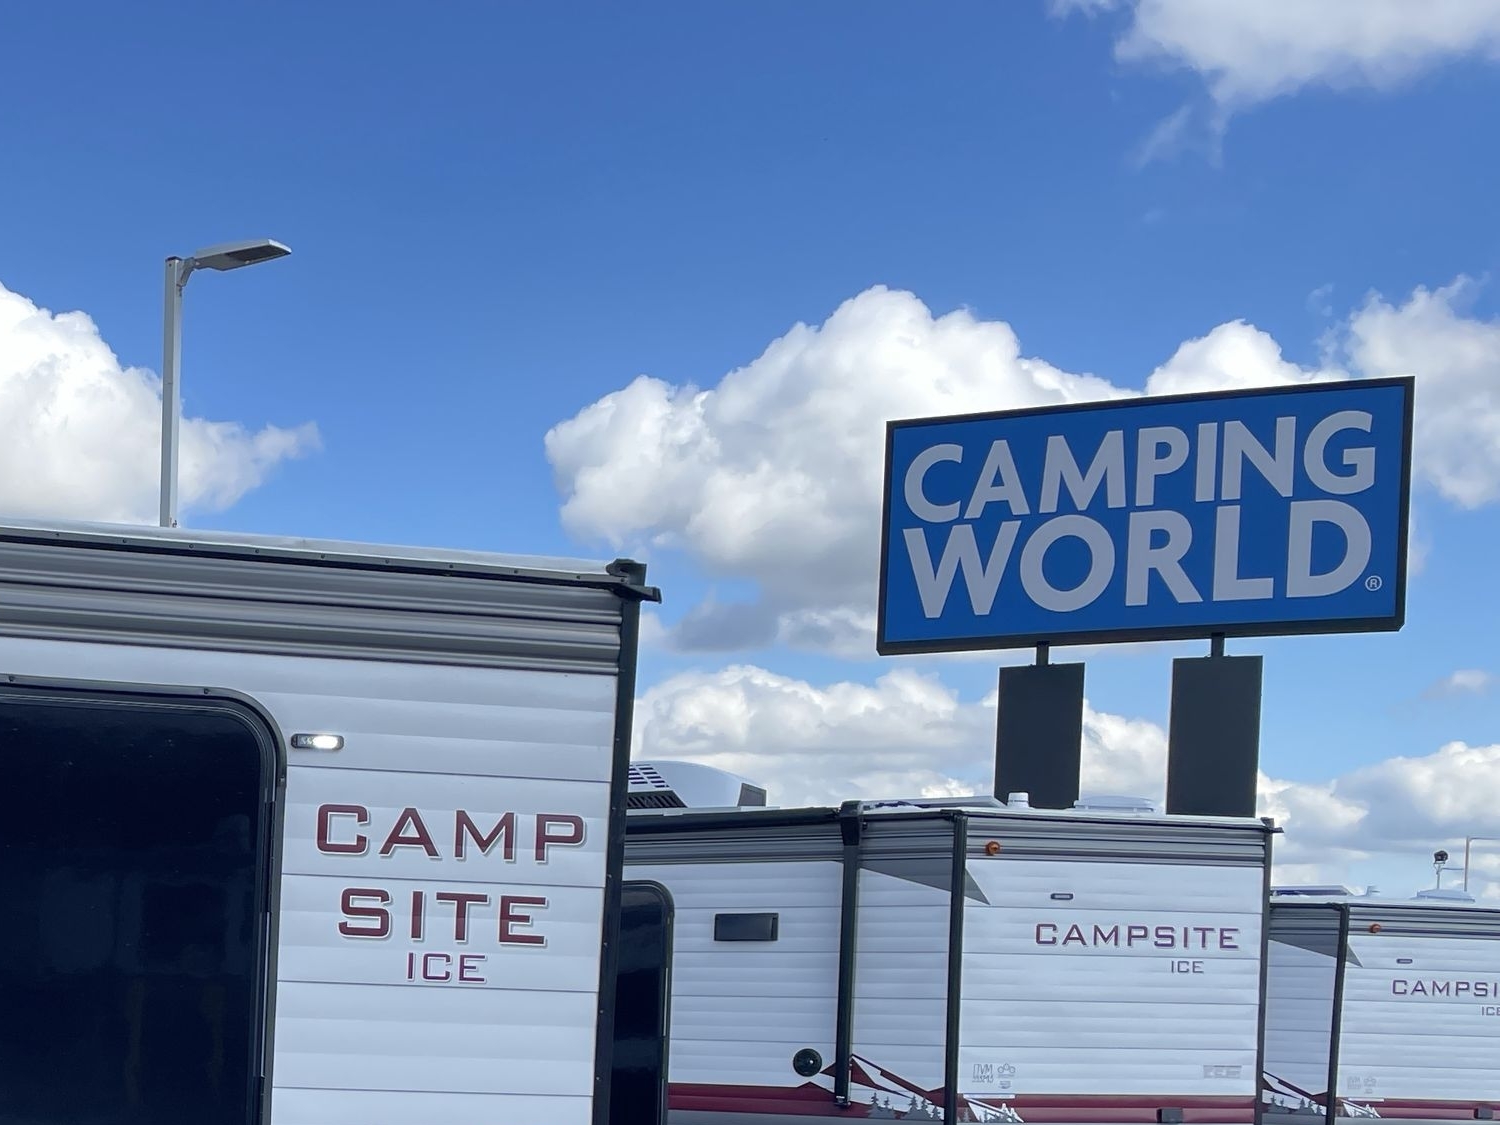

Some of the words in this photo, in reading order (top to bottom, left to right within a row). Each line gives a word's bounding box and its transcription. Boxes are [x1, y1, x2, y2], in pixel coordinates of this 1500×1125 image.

[904, 410, 1376, 523] CAMPING
[903, 499, 1372, 618] WORLD
[316, 802, 586, 864] CAMP
[338, 887, 548, 946] SITE
[1035, 923, 1240, 950] CAMPSITE
[406, 952, 488, 983] ICE
[1170, 960, 1205, 974] ICE
[1392, 979, 1499, 998] CAMPSI
